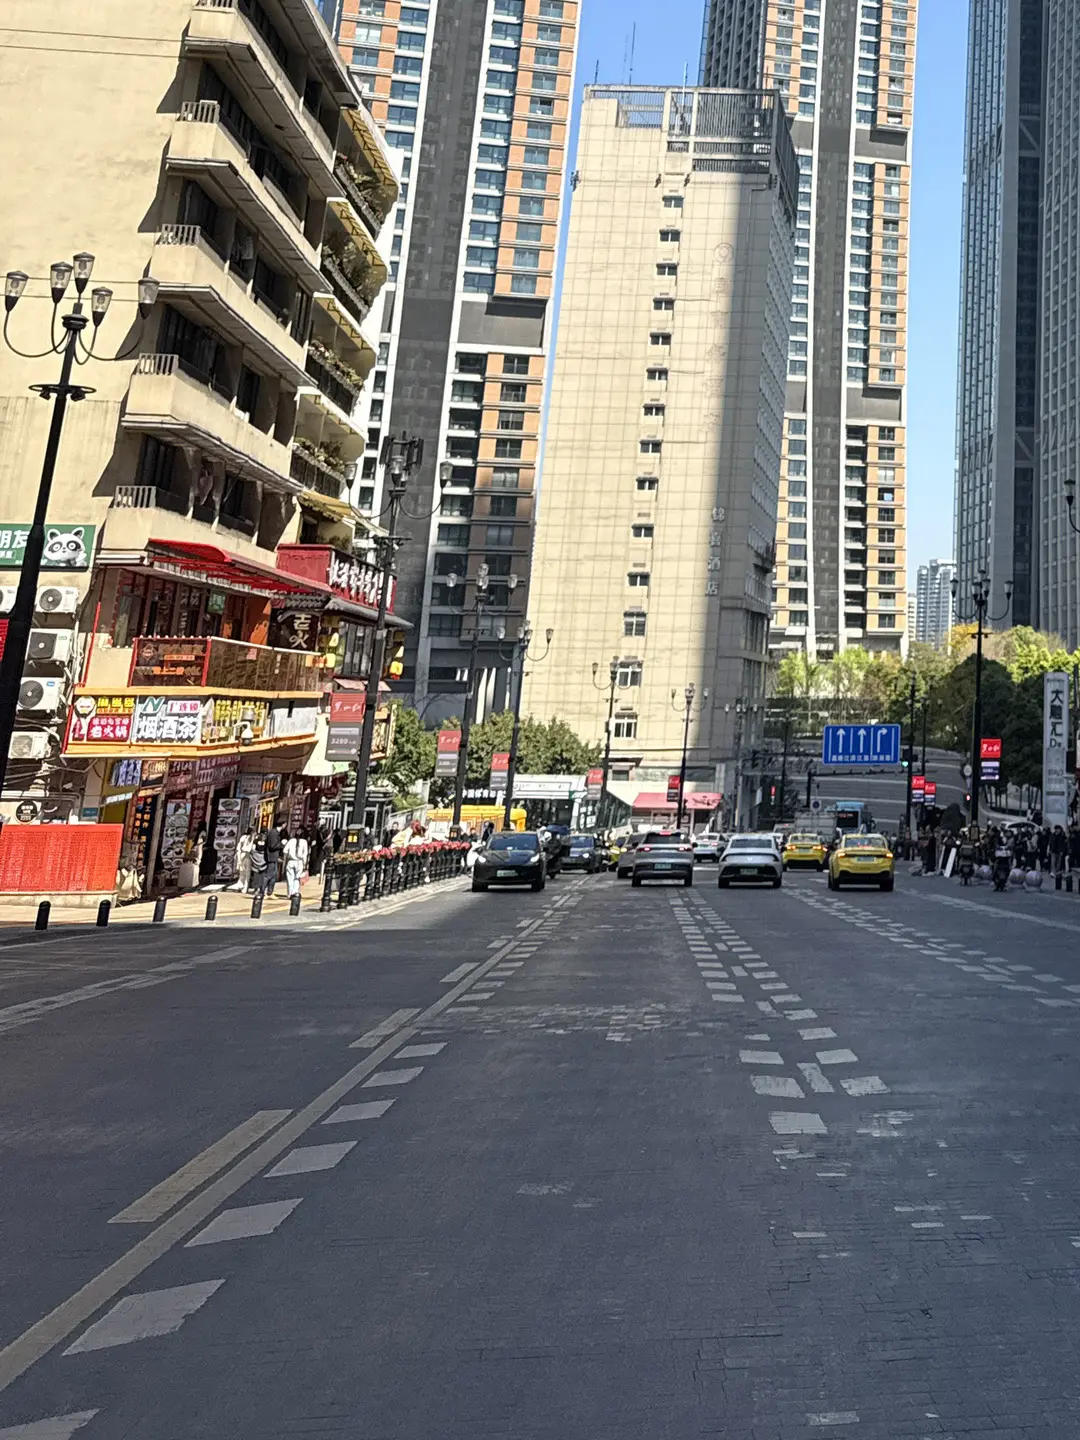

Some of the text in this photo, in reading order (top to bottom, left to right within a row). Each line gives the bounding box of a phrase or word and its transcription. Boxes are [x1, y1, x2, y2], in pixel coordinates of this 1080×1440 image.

[138, 717, 200, 740] 烟酒茶
[1049, 689, 1064, 736] 大融汇
